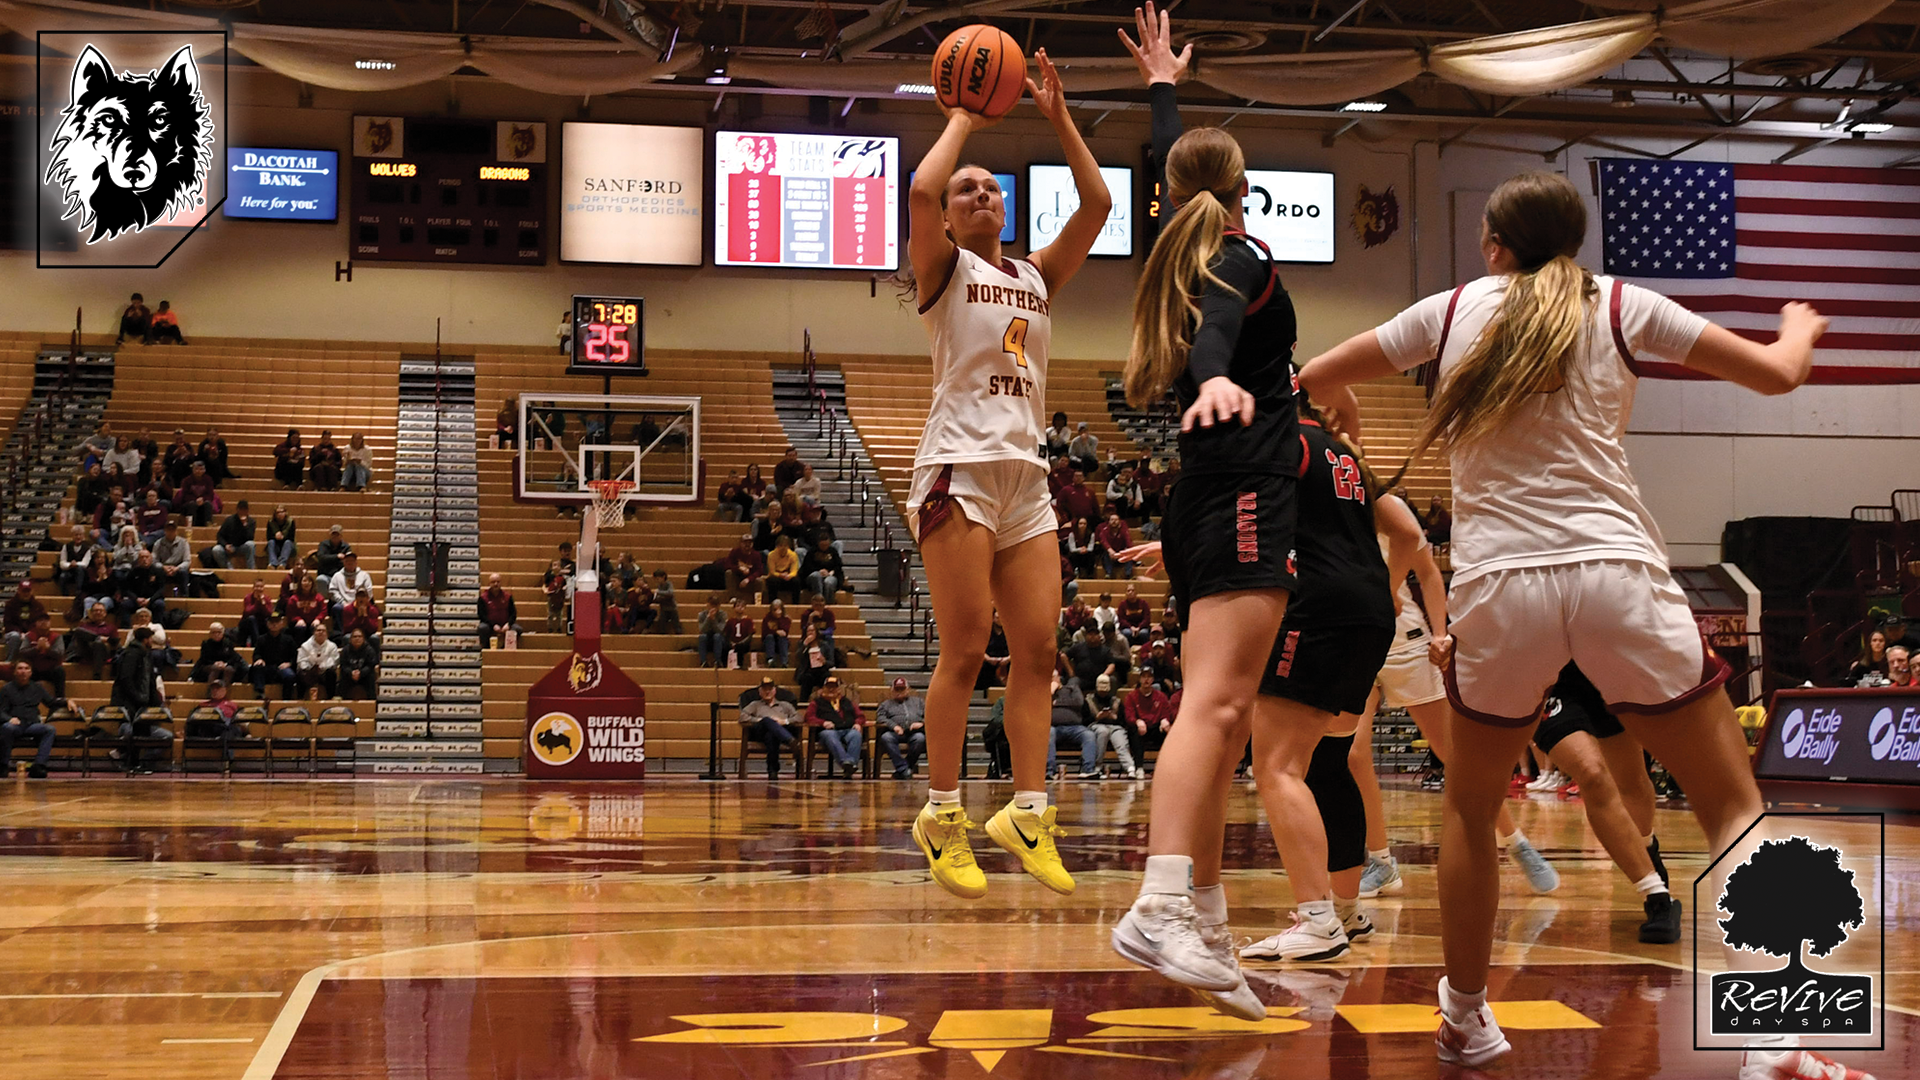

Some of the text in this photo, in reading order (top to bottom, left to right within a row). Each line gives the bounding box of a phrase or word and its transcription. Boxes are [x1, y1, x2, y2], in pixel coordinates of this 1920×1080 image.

[967, 47, 991, 95] NCAA
[244, 152, 317, 169] DACOTAH
[370, 163, 416, 177] WOLVES
[480, 166, 530, 181] DRAGONS
[240, 195, 269, 208] Here
[267, 196, 289, 212] for
[581, 195, 685, 206] ORTHOPEDICS
[566, 203, 700, 216] SPORTS MEDICINE
[594, 303, 637, 324] 7:28
[586, 324, 629, 361] 25
[1003, 316, 1029, 369] 4
[587, 716, 645, 728] BUFFALO
[1807, 708, 1843, 733] Eide
[588, 728, 645, 748] WILD
[588, 748, 646, 763] WINGS
[1798, 734, 1840, 766] Bailly
